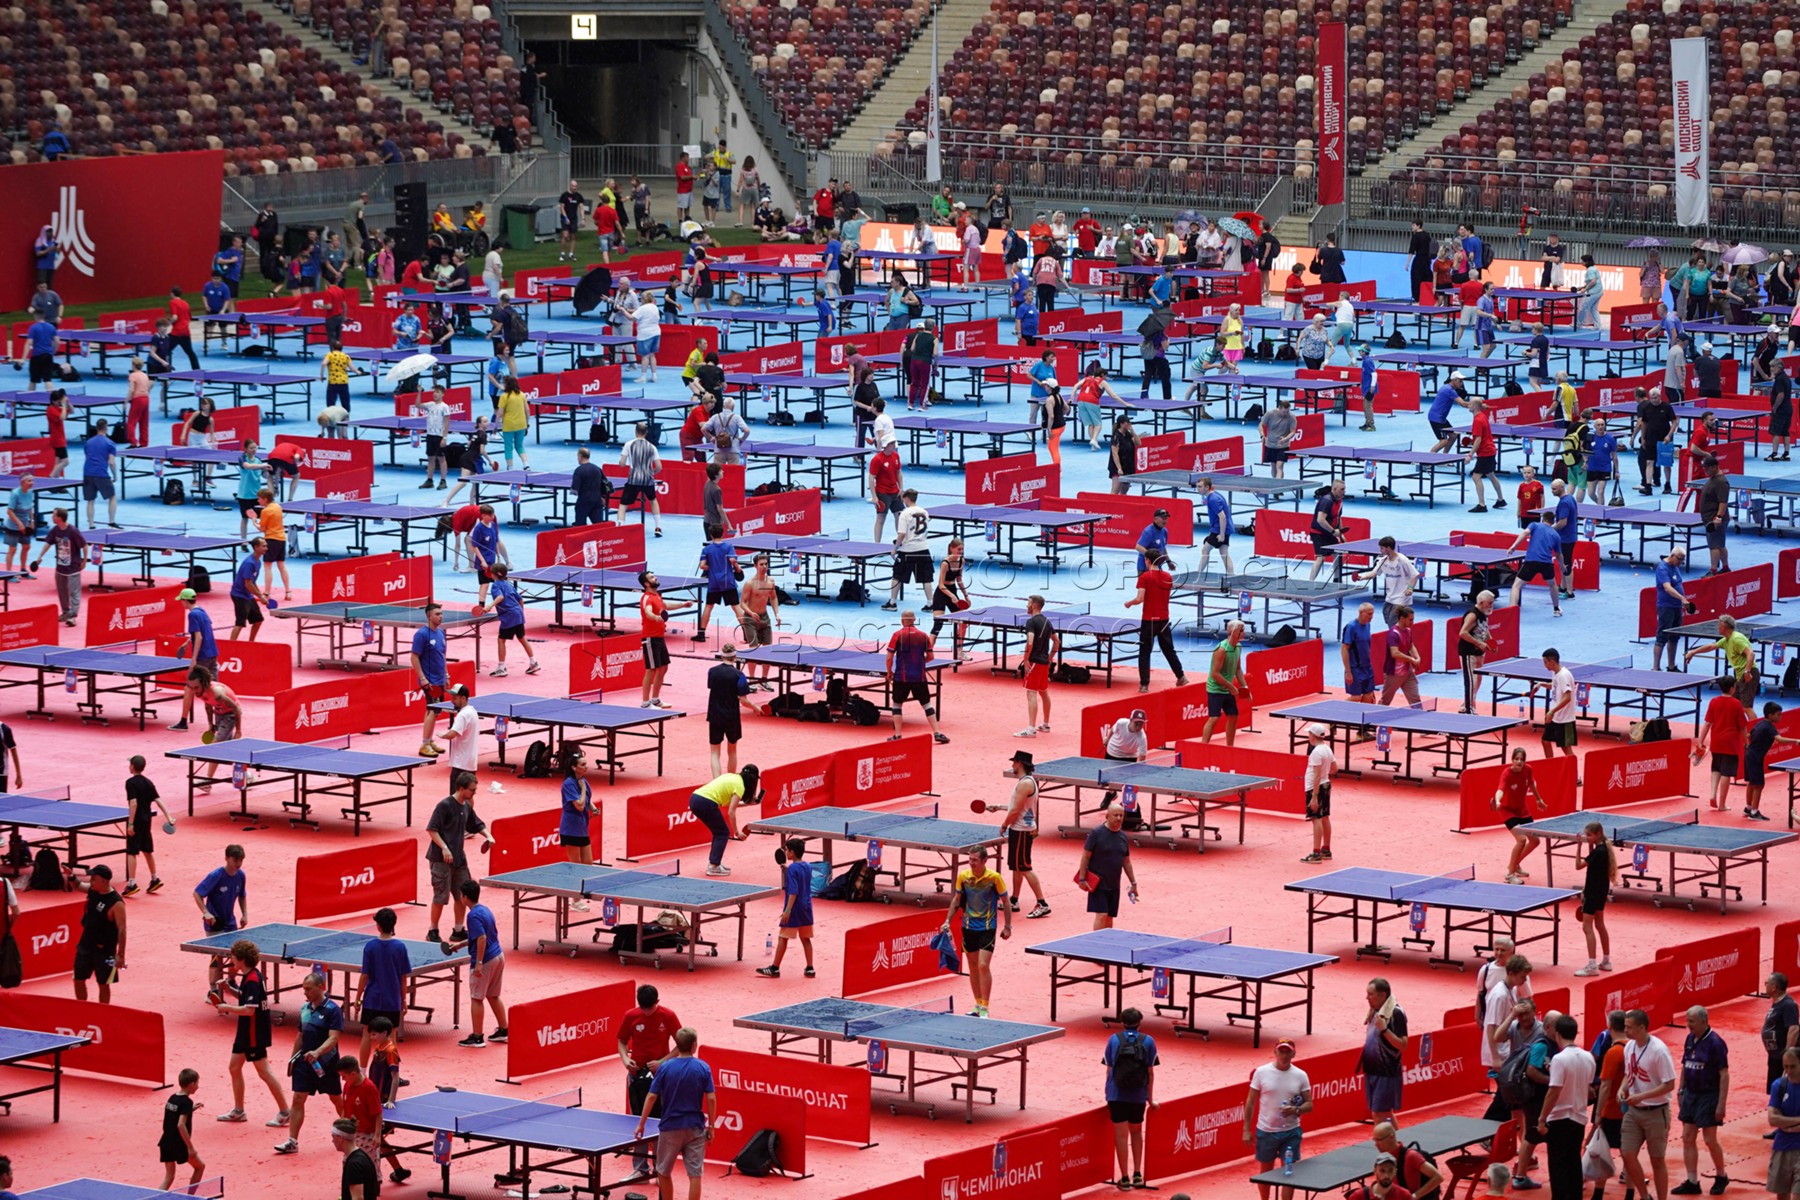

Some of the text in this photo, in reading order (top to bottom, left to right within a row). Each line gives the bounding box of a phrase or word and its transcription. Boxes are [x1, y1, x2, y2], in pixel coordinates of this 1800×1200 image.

[577, 18, 591, 36] 4
[1322, 65, 1333, 135] МОСКОВСКИЙ
[1331, 102, 1340, 133] СПОРТ
[1675, 80, 1691, 153] МОСКОВСКИЙ
[1691, 118, 1702, 152] СПОРТ
[646, 263, 676, 276] ЕМПИОНАТ
[1204, 448, 1230, 463] МОСКОВСКИЙ
[312, 458, 331, 470] СПОРТ
[1020, 475, 1046, 490] МОСКОВСКИЙ
[775, 510, 806, 524] taSPORT
[1736, 577, 1760, 595] МОСКОВСКИЙ
[126, 599, 165, 616] МОСКОВСКИЙ
[1736, 594, 1748, 607] СПОРТ
[125, 615, 144, 629] СПОРТ
[1774, 649, 1782, 658] 22
[606, 664, 624, 678] СПОРТ
[815, 674, 822, 682] 25
[1266, 665, 1309, 685] VistaSPORT
[311, 693, 349, 713] МОСКОВСКИЙ
[311, 711, 329, 726] СПОРТ
[875, 753, 907, 766] Департамент
[1626, 755, 1668, 774] МОСКОВСКИЙ
[875, 766, 892, 774] спорта
[875, 771, 911, 784] города Москвы
[1626, 773, 1646, 788] СПОРТ
[790, 791, 806, 807] СПОРТ
[1126, 792, 1133, 802] 16
[871, 847, 878, 857] 14
[1636, 852, 1645, 862] 15
[605, 906, 615, 916] 12
[1414, 911, 1422, 921] 13
[891, 952, 914, 968] СПОРТ
[1697, 949, 1739, 975] МОСКОВСКИЙ
[1156, 977, 1165, 987] 11
[1695, 972, 1716, 992] СПОРТ
[537, 1017, 610, 1047] VistaSPORT
[872, 1050, 878, 1060] 9
[1403, 1054, 1463, 1089] istaSPORT
[1194, 1102, 1245, 1132] МОСКОВСКИЙ
[439, 1141, 444, 1152] 7
[1194, 1129, 1218, 1150] СПОРТ
